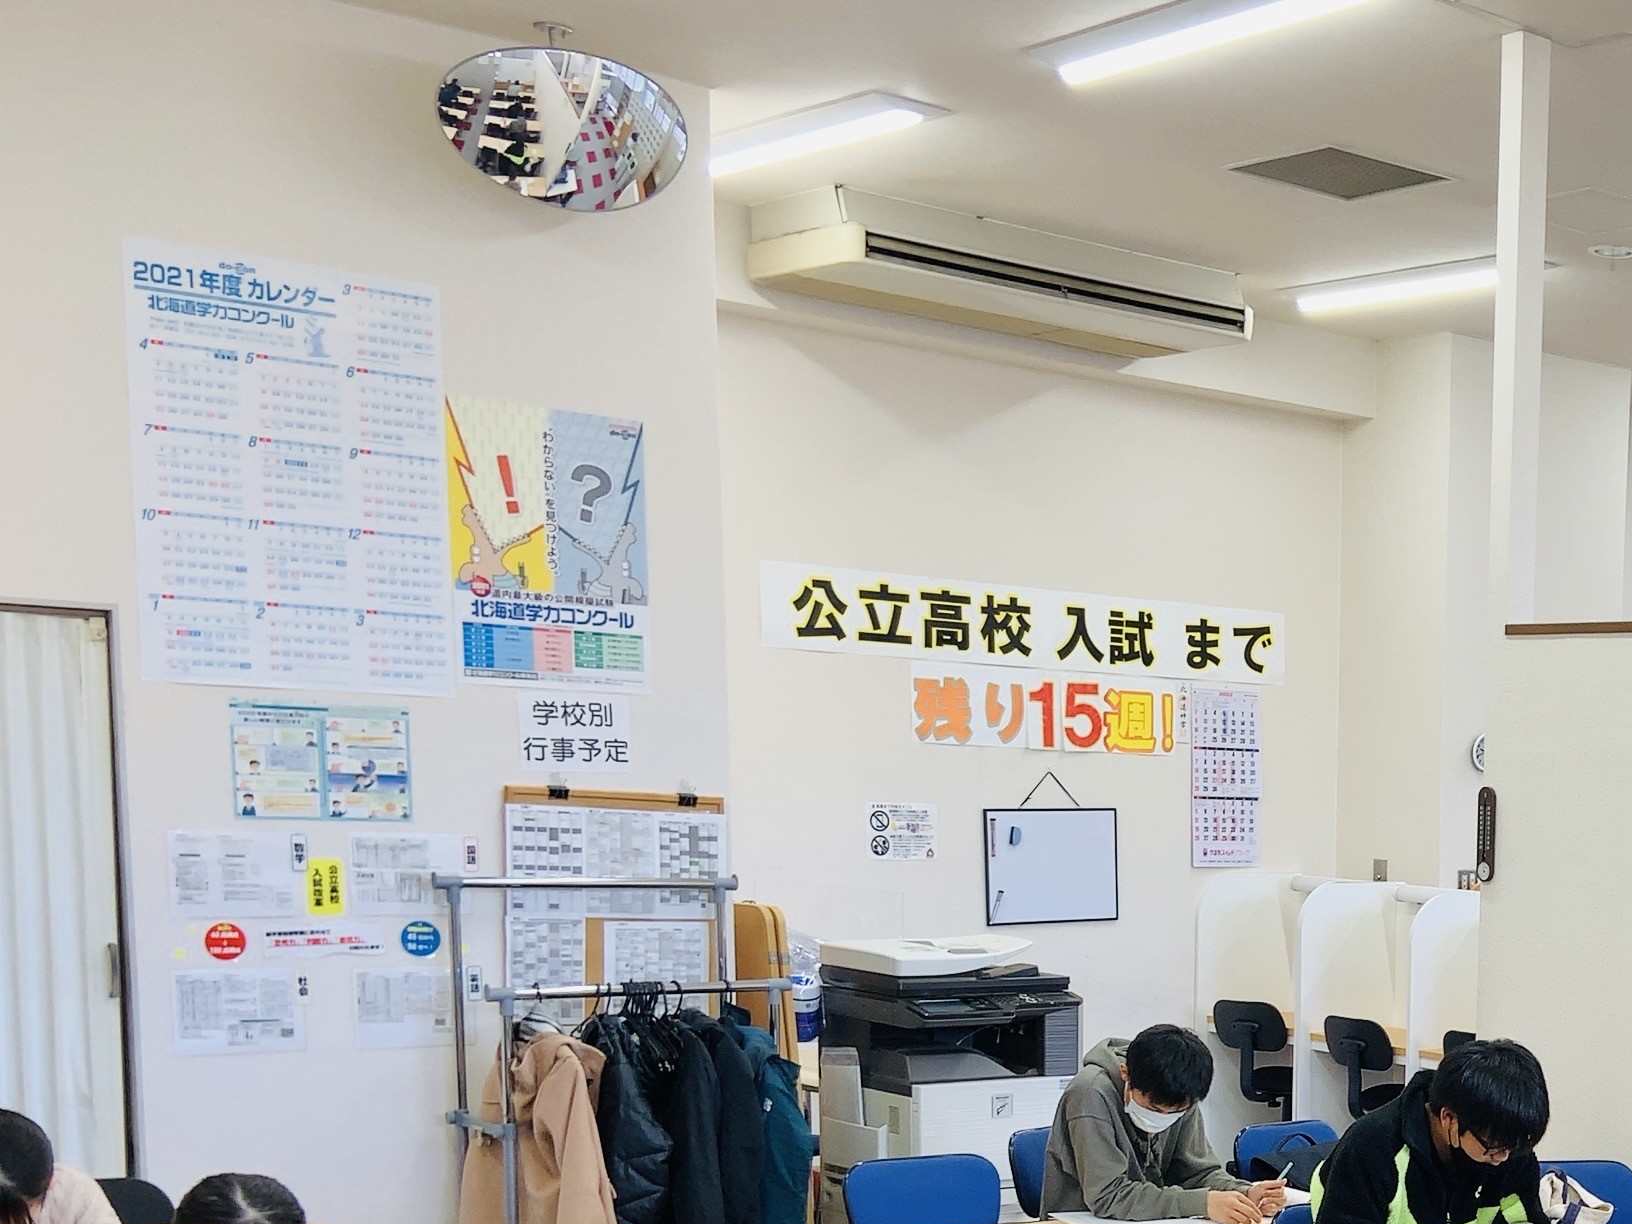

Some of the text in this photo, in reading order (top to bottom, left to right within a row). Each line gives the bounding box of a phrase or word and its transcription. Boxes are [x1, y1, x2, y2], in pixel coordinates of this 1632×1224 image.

[133, 261, 336, 307] 2021年度 カレンダー
[148, 295, 295, 329] 北海道学力コンクール
[471, 600, 635, 629] 北海道学力コンクール
[791, 578, 1274, 674] 公立高校 入試 まで
[533, 700, 613, 727] 学校別
[523, 737, 629, 763] 行事予定
